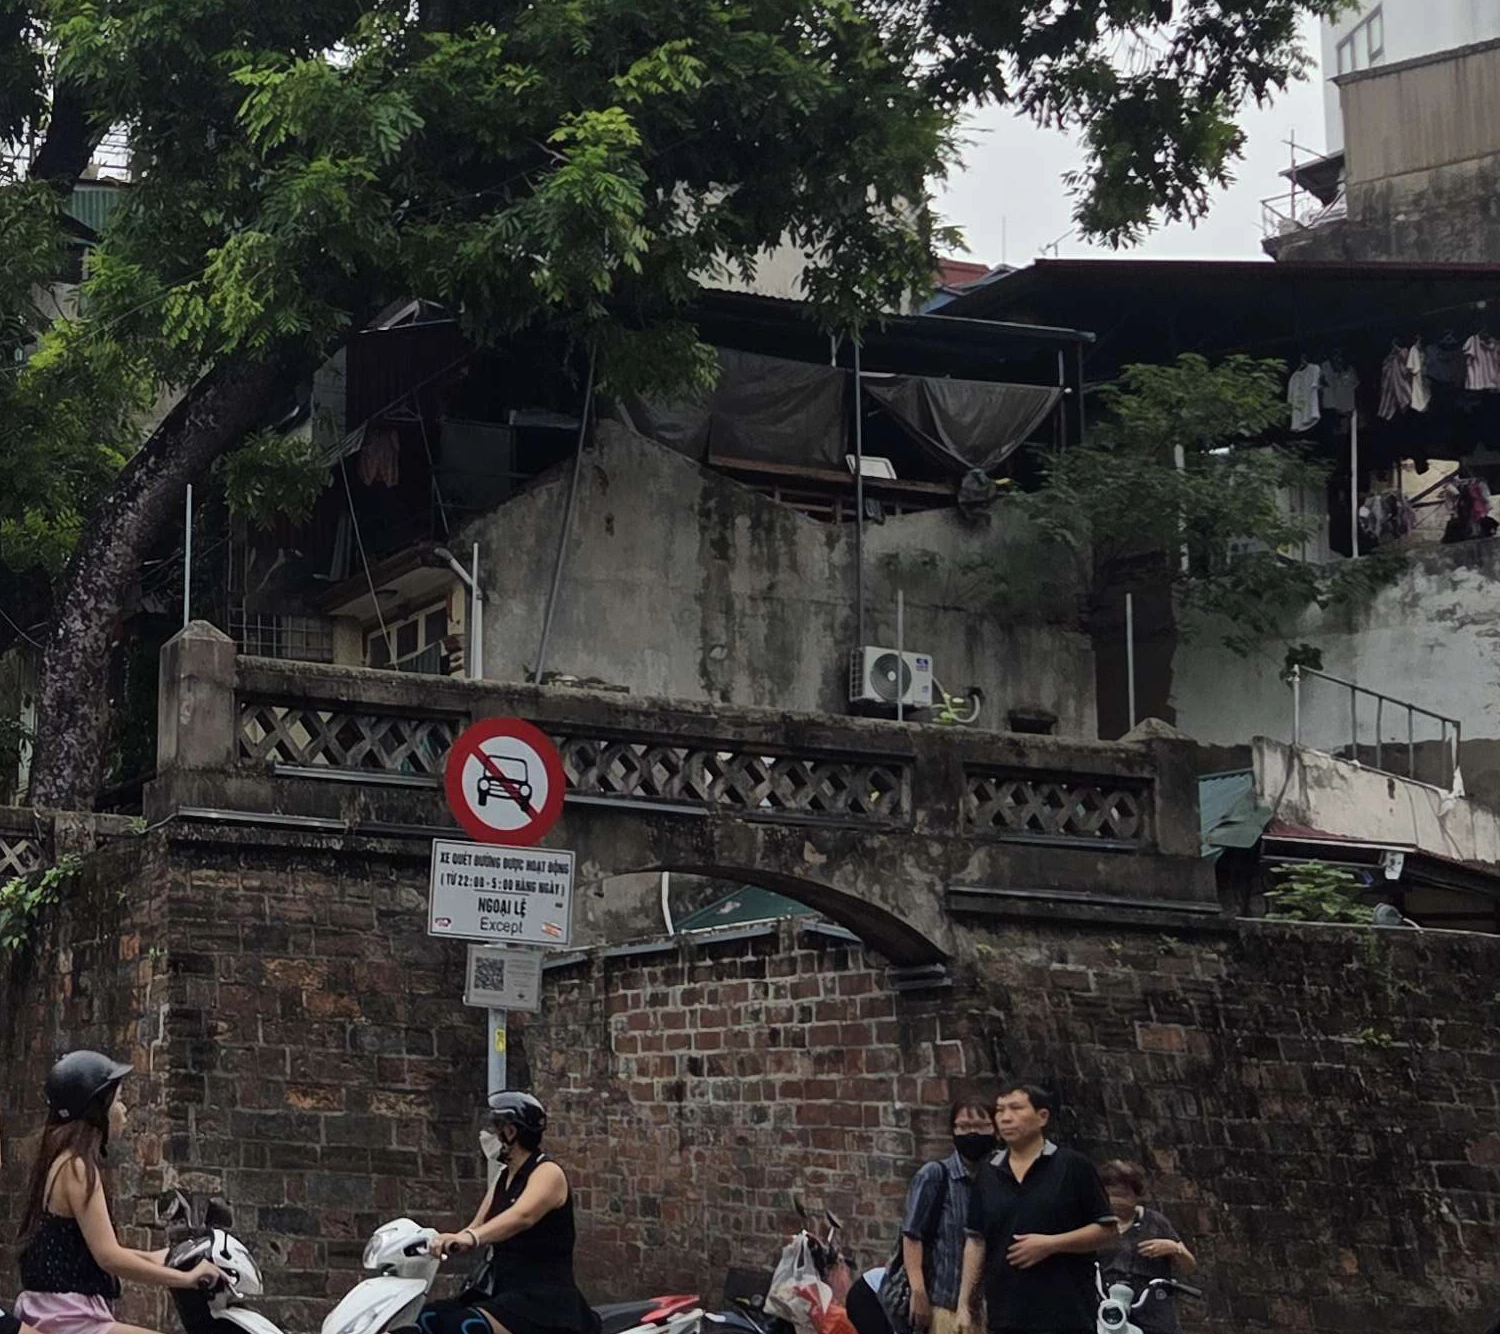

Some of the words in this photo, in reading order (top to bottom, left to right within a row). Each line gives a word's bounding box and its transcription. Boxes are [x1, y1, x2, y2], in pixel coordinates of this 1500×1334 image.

[440, 852, 450, 864] XE
[446, 870, 457, 886] TỪ
[478, 897, 511, 917] NGOẠI
[514, 898, 527, 918] LỆ
[480, 917, 524, 936] Except
